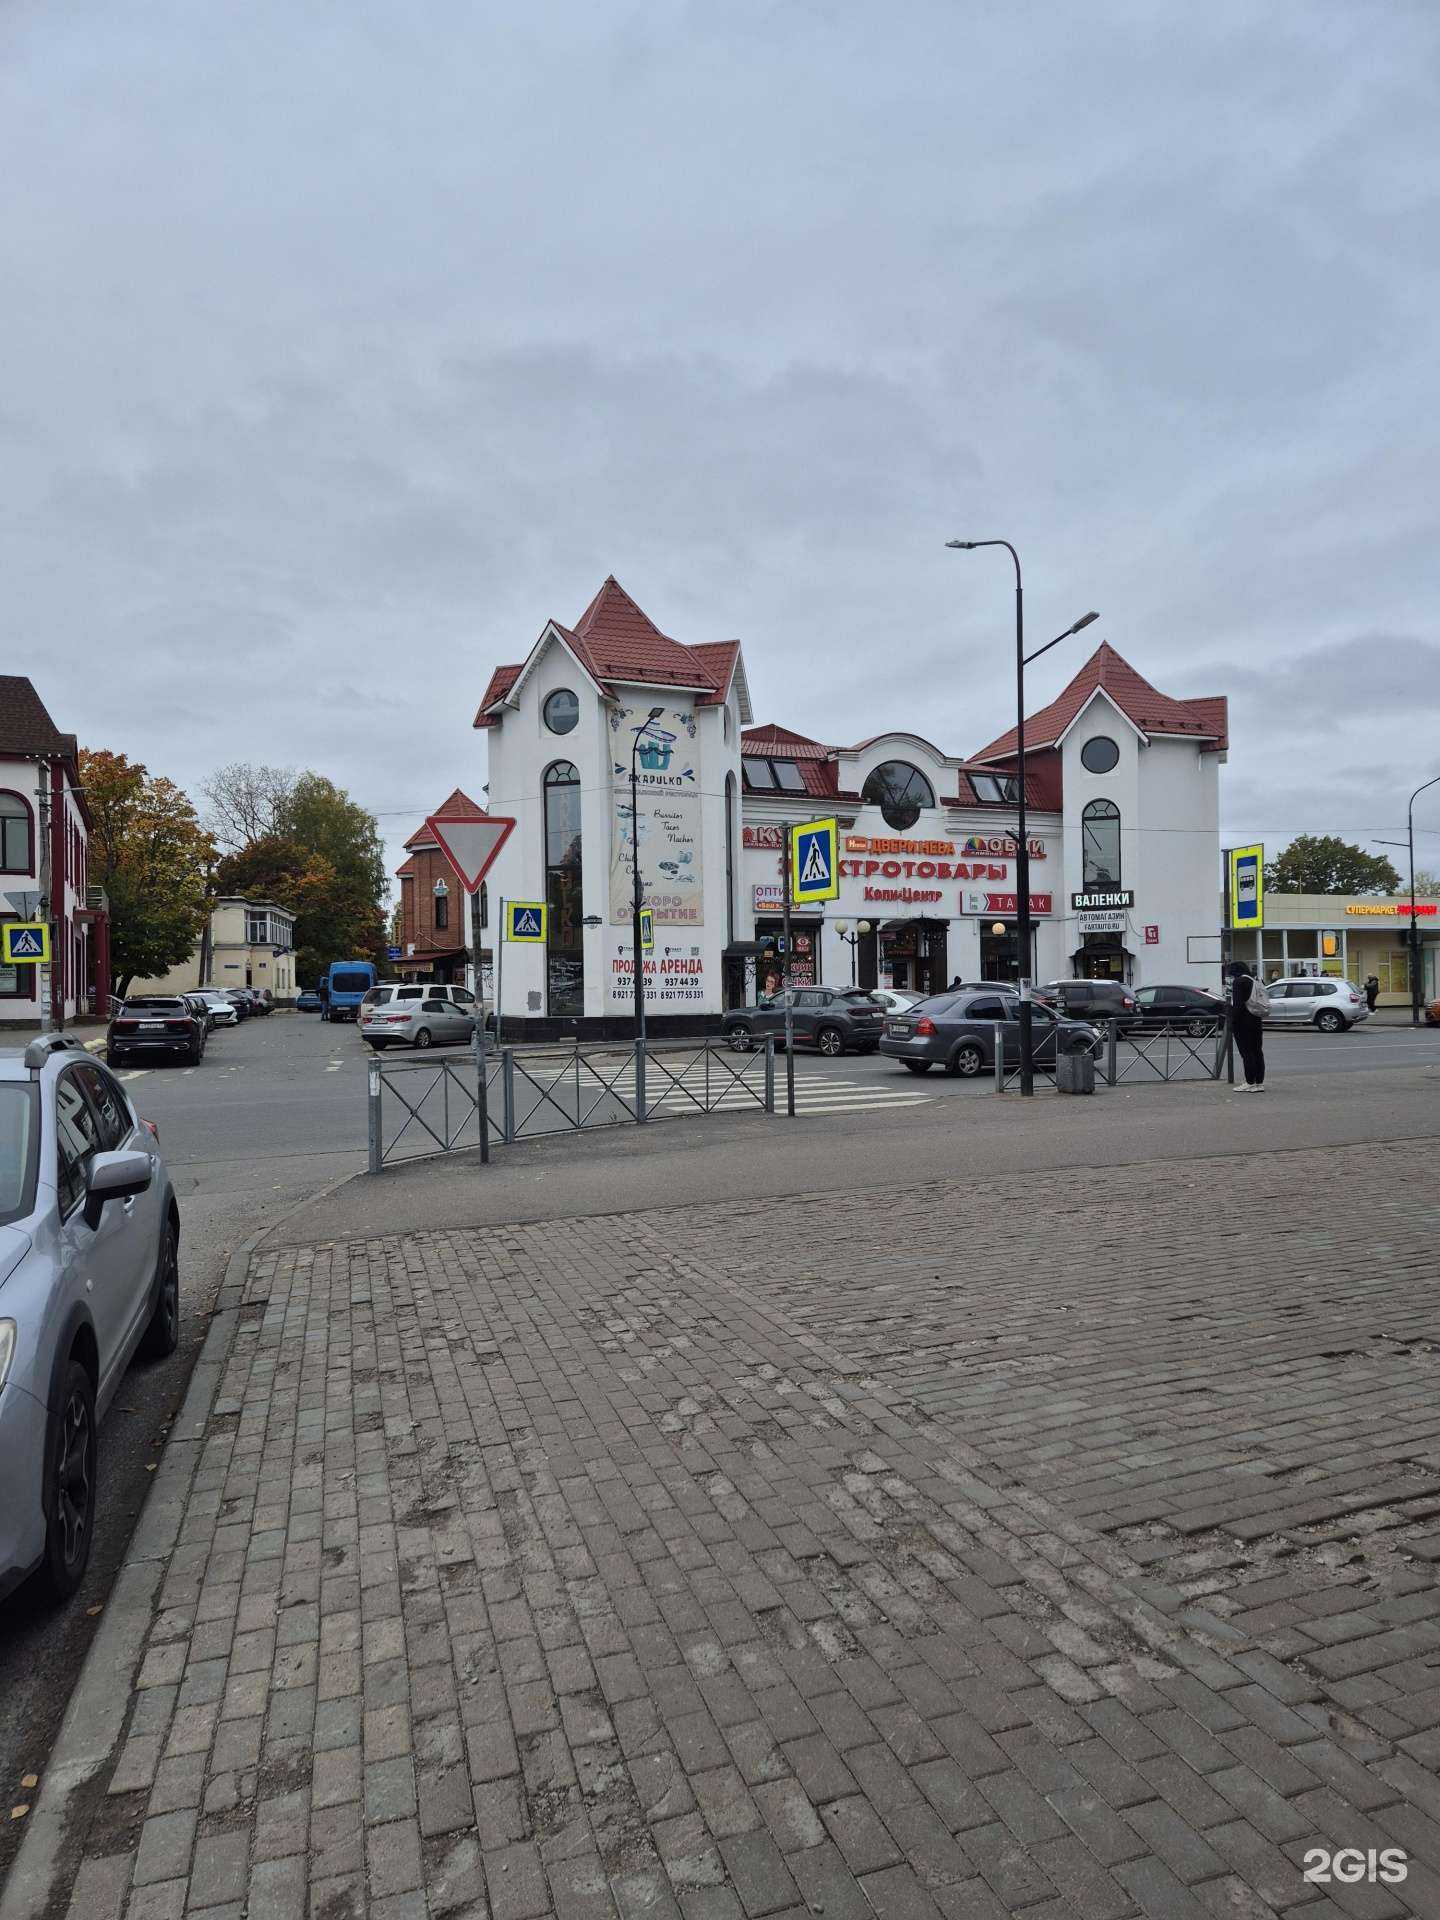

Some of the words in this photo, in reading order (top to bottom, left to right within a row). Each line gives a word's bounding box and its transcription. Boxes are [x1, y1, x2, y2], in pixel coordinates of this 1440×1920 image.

[667, 833, 694, 844] Nachos
[988, 838, 1046, 853] ОБИ
[996, 897, 1045, 909] ТААК
[1075, 892, 1130, 907] ВАЛЕНКИ
[1080, 912, 1125, 921] АВТОМАГАЗИН
[612, 959, 657, 974] ПРОДЖА
[660, 959, 704, 975] АРЕНДА
[617, 977, 631, 986] 937
[665, 978, 678, 986] 937
[680, 978, 689, 986] 44
[690, 978, 699, 986] 39
[665, 991, 676, 999] 921
[677, 991, 685, 999] 77
